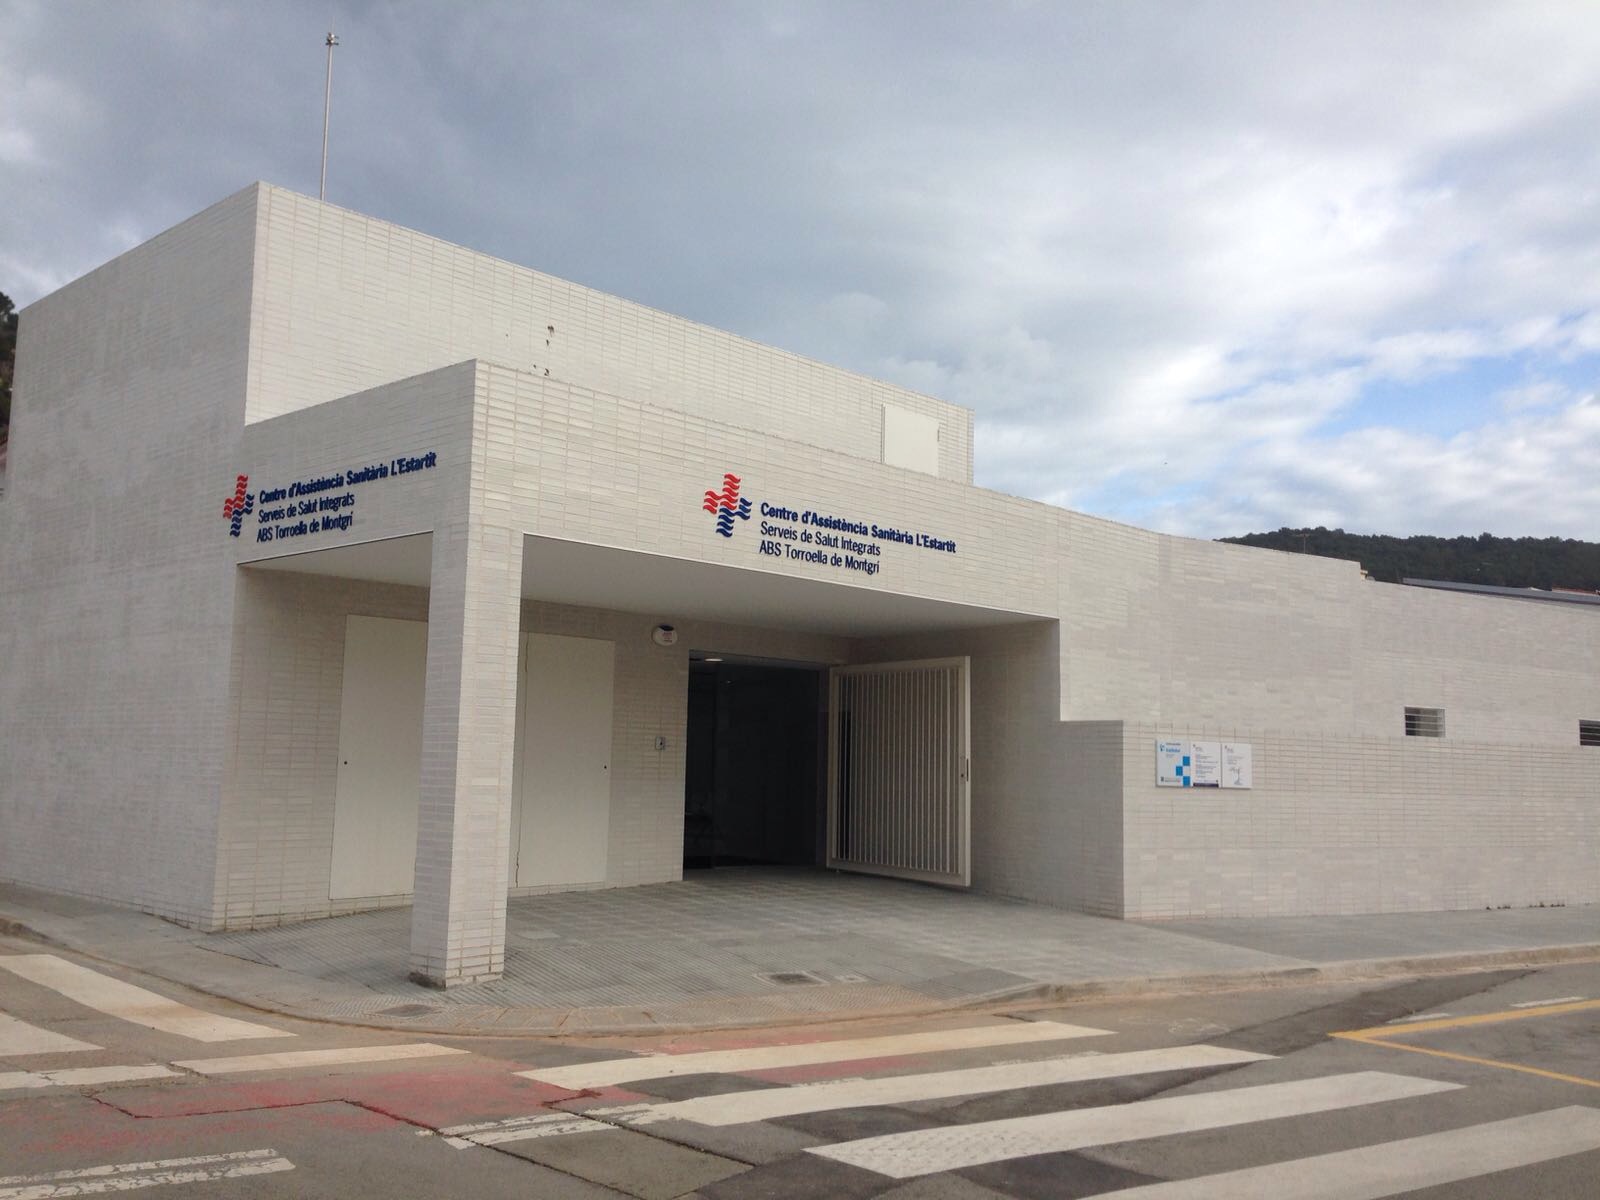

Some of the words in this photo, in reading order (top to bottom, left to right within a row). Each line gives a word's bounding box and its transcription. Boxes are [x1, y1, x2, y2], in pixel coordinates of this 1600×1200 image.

[260, 488, 286, 504] Centre
[346, 463, 388, 485] Sanitària
[258, 505, 285, 523] Serveis
[287, 503, 296, 517] de
[298, 499, 317, 516] Salut
[319, 493, 355, 512] Integrats
[257, 527, 272, 543] ABS
[275, 521, 307, 539] Torroella
[309, 518, 319, 532] de
[760, 521, 798, 540] Serveis
[800, 529, 813, 543] de
[815, 531, 839, 548] Salut
[841, 537, 881, 557] Integrats
[761, 502, 798, 521] Centre
[801, 509, 868, 536] d'Assistència
[871, 526, 914, 545] Sanitària
[916, 534, 956, 553] L'Estartit
[759, 540, 781, 557] ABS
[785, 544, 828, 565] Torroella
[830, 552, 842, 567] de
[844, 555, 880, 575] Montgrí
